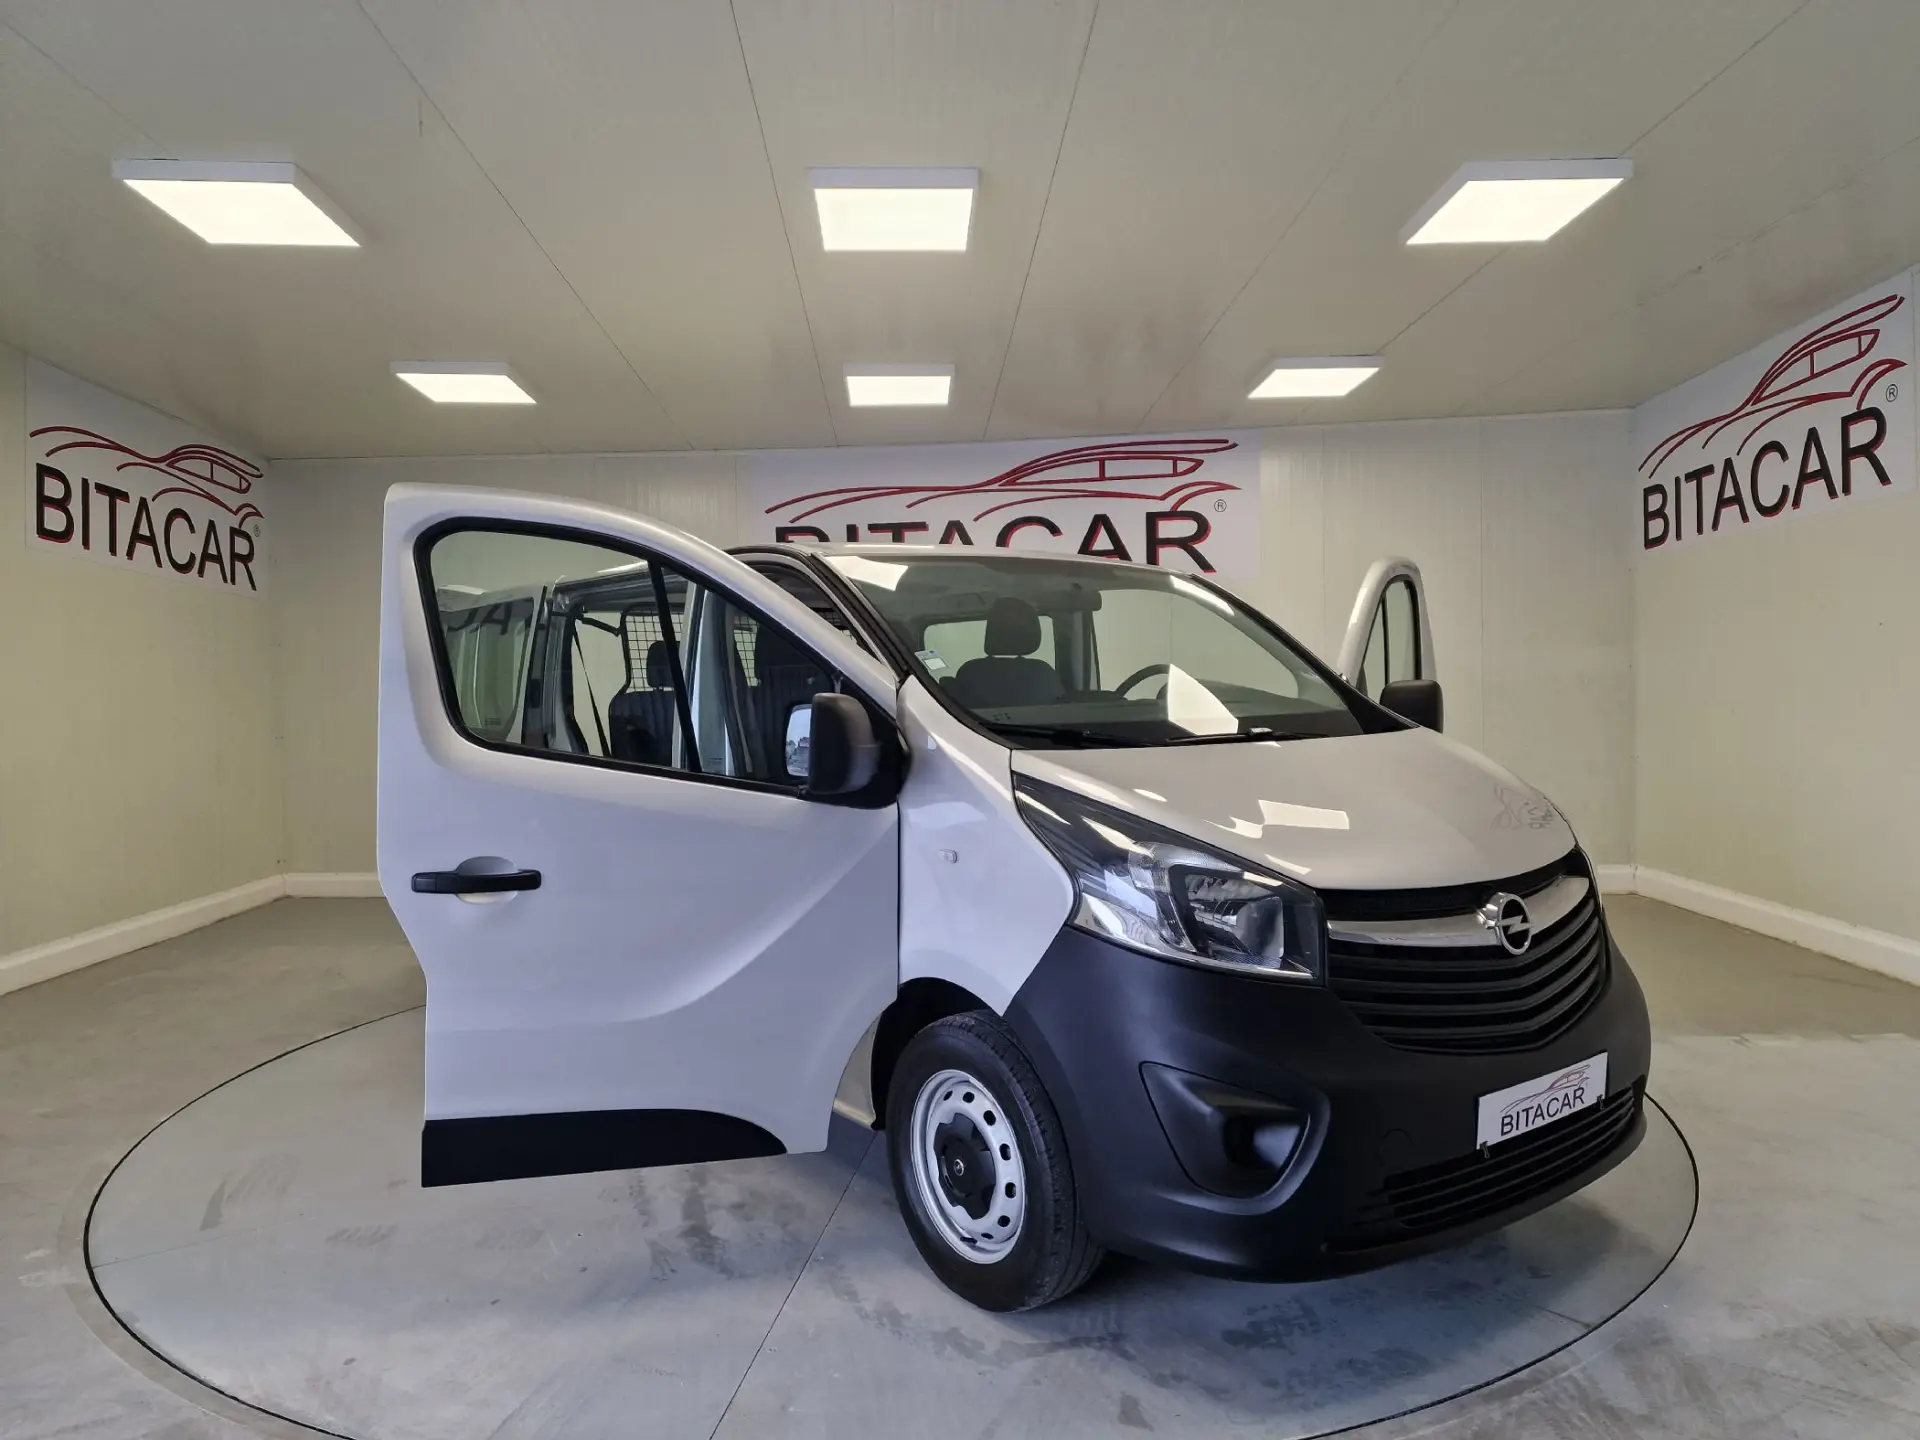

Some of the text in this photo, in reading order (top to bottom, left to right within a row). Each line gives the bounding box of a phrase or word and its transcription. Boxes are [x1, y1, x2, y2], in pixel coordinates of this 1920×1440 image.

[35, 462, 257, 591] BITACAR
[1643, 407, 1892, 550] BITACAR
[1500, 1087, 1585, 1136] BITACAR
